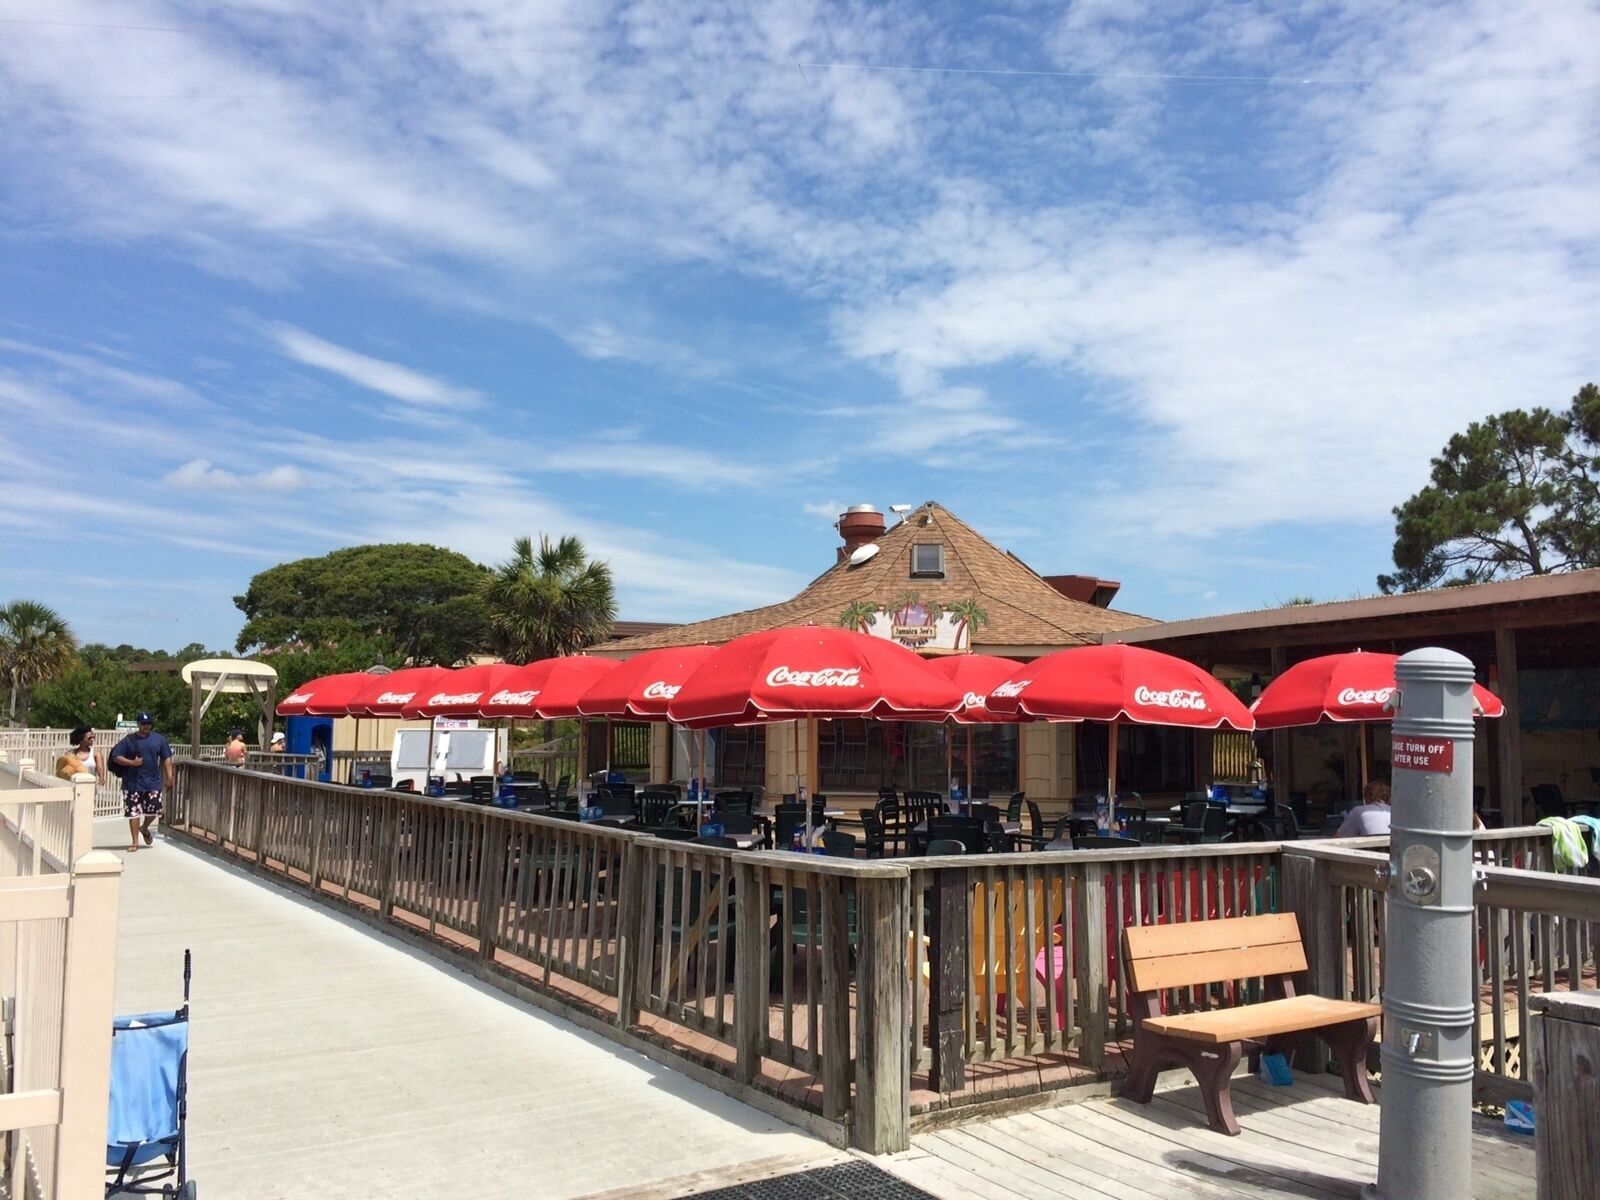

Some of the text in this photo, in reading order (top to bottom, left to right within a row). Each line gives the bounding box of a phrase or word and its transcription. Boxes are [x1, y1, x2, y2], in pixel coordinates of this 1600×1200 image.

[765, 665, 863, 687] Coca-Cola
[1134, 685, 1207, 711] Coca-Cola
[1337, 687, 1396, 706] Coca-C
[1406, 743, 1425, 753] TURN
[1428, 745, 1445, 754] OFF
[1394, 753, 1430, 766] AFTER USE
